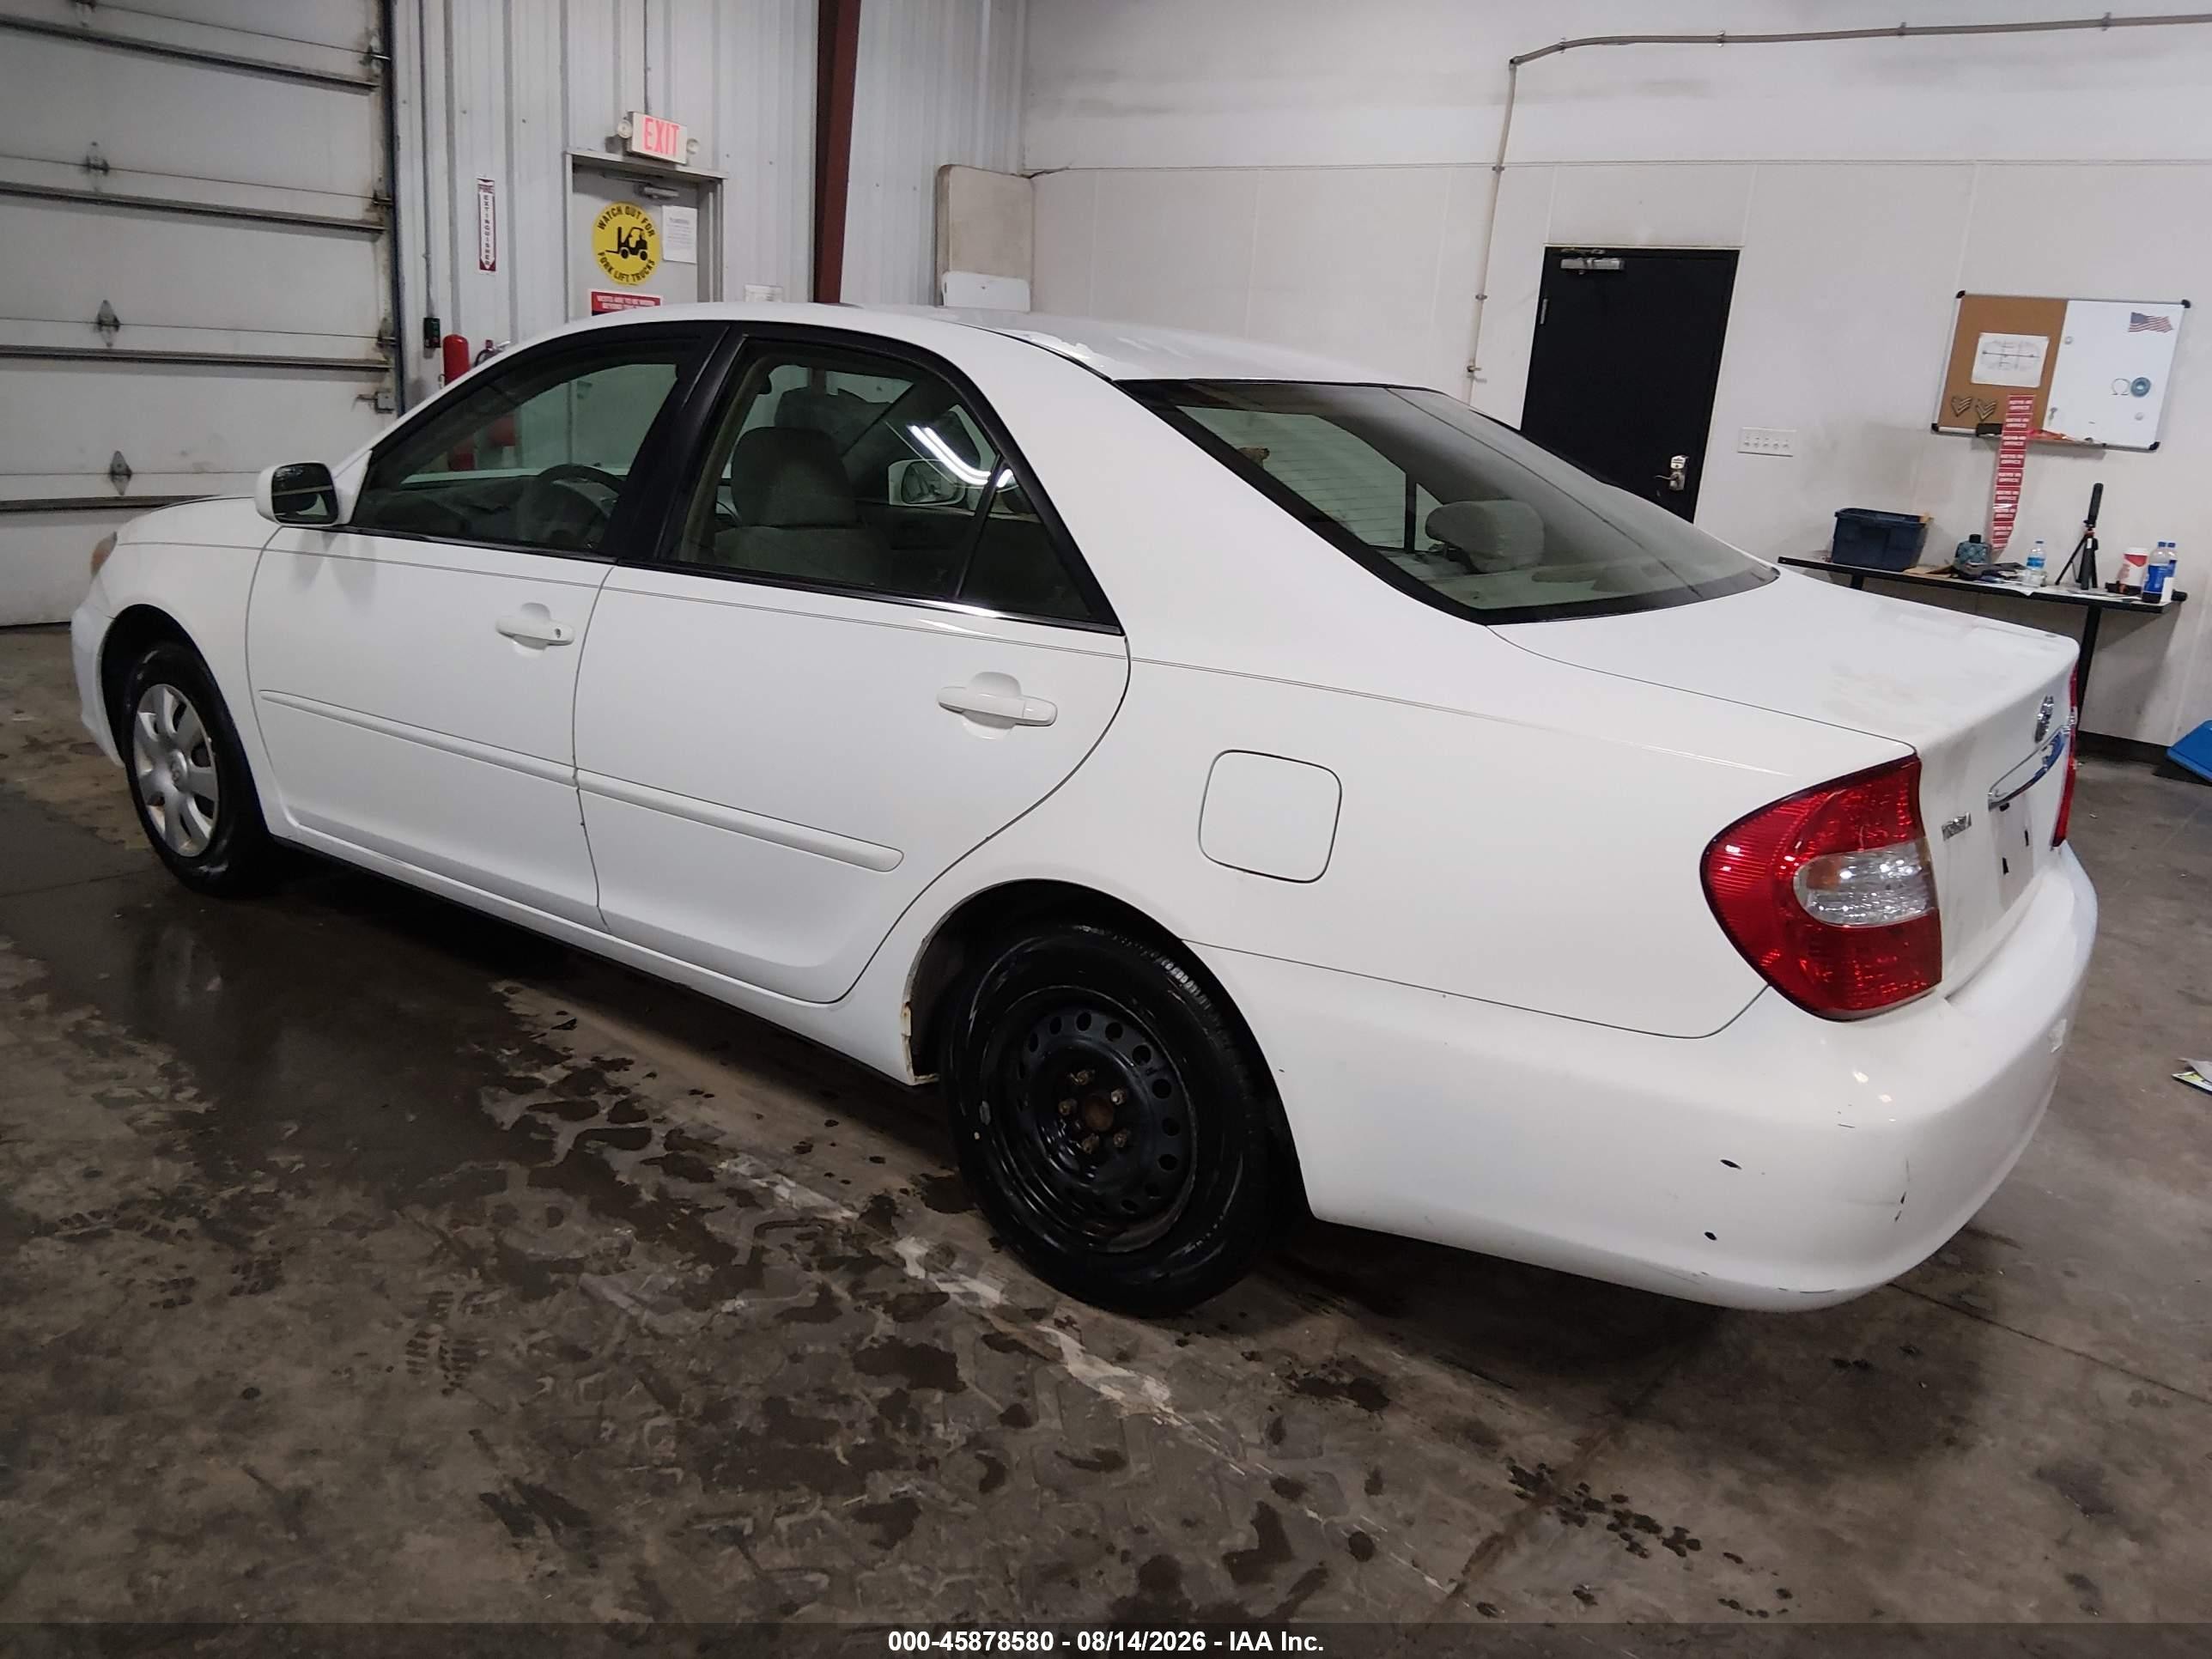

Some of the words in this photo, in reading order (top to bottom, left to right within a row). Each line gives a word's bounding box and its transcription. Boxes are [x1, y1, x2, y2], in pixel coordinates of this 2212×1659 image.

[643, 118, 680, 157] EXIT
[597, 206, 623, 230] WATCH
[625, 206, 642, 220] OUT
[641, 217, 655, 237] FOR
[598, 252, 615, 275] FORK
[613, 269, 629, 283] LIFT
[631, 258, 655, 283] TRUCKS
